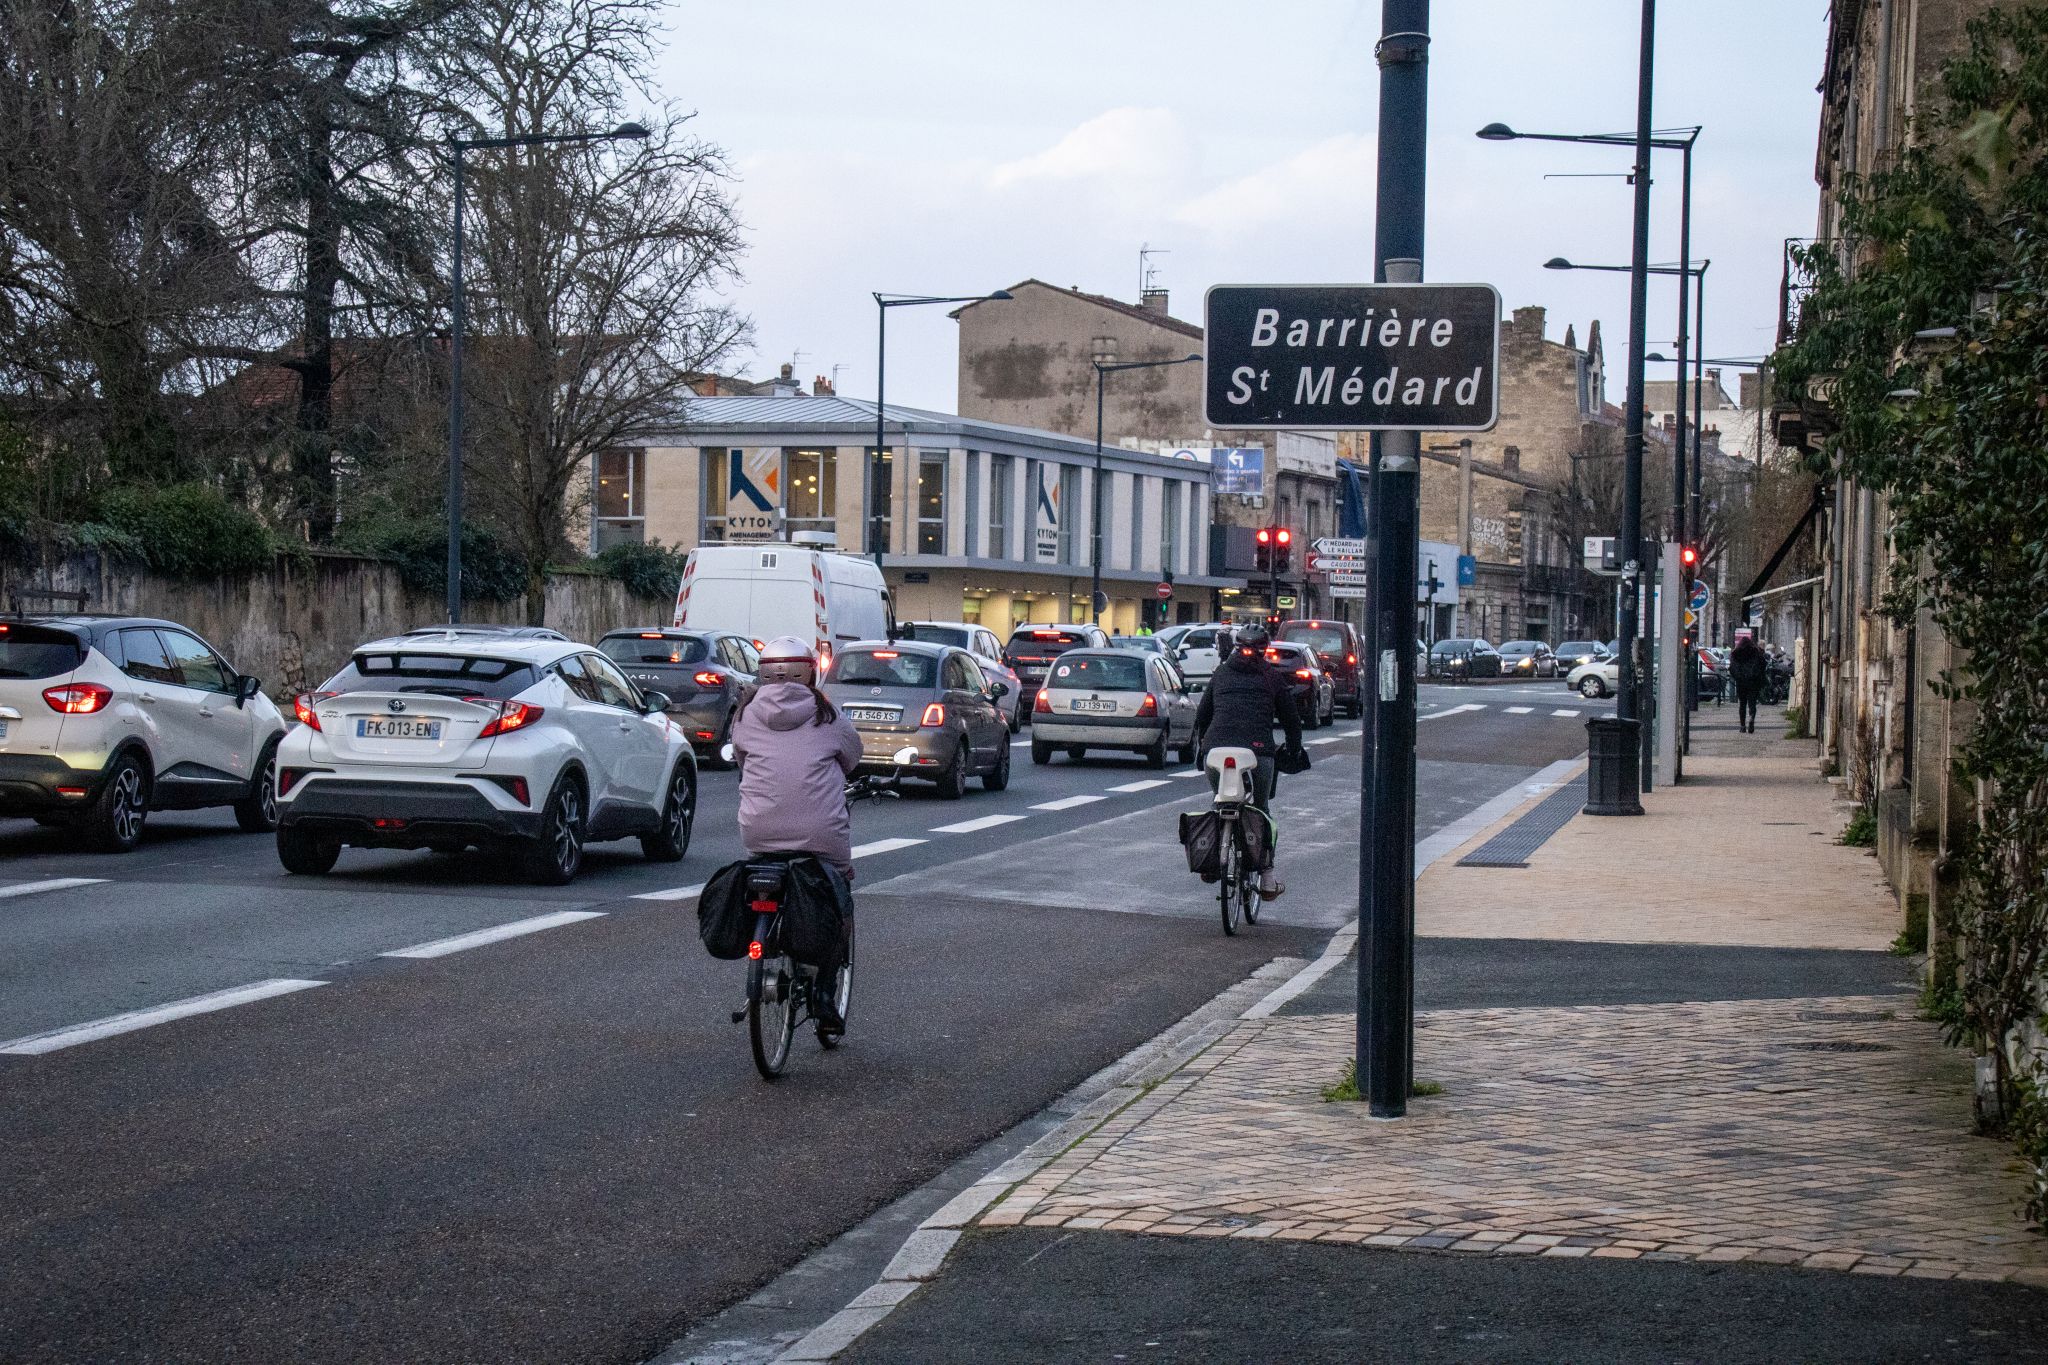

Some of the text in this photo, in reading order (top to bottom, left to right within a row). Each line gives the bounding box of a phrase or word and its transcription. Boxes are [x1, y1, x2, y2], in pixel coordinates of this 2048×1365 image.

[1251, 308, 1453, 348] Barrière
[1227, 366, 1482, 406] St Médard
[367, 721, 432, 736] FK-013-EN
